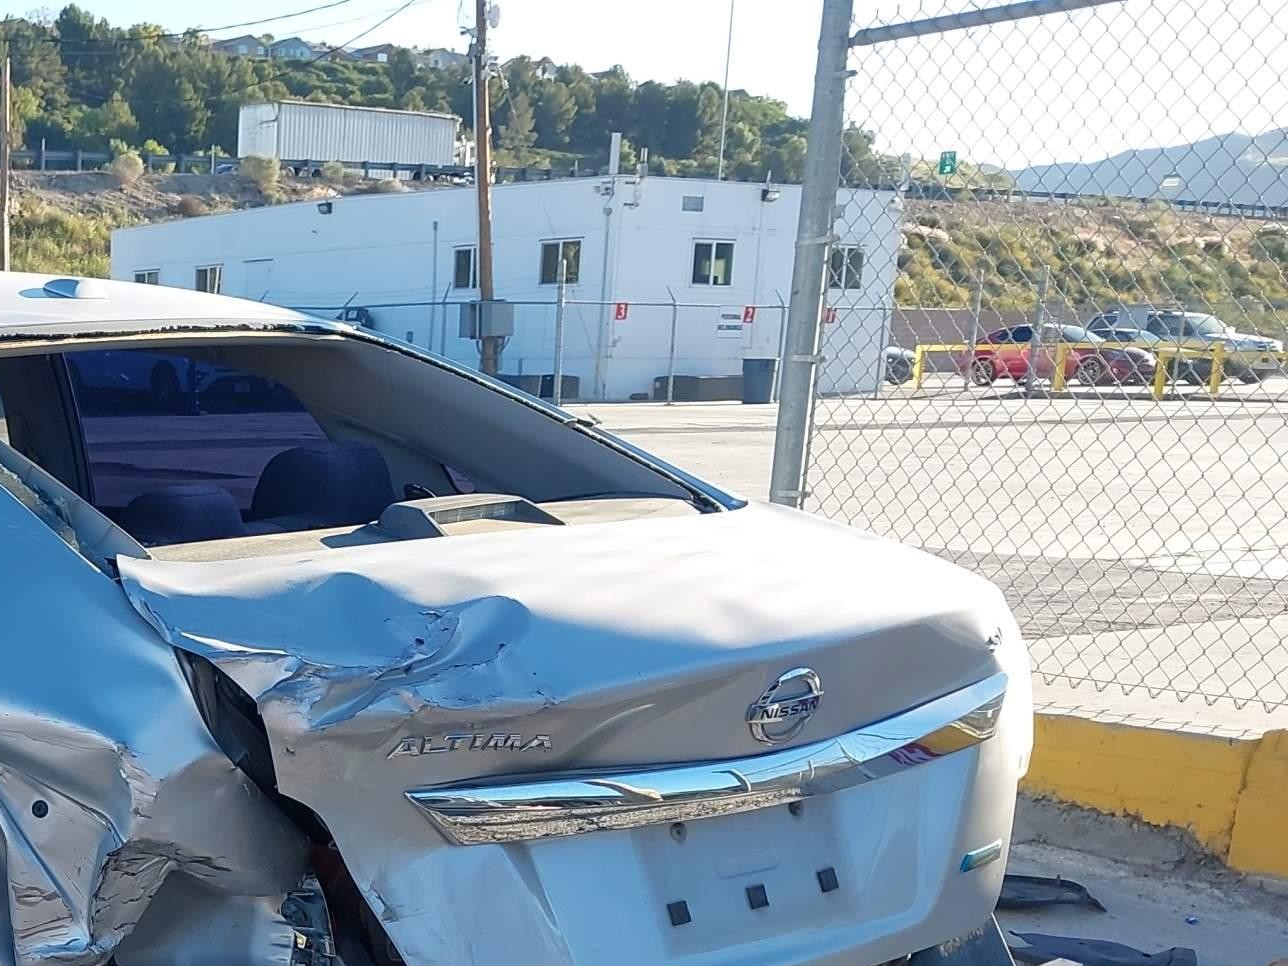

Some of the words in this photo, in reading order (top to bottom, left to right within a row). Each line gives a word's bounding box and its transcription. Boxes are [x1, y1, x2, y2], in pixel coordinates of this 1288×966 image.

[617, 303, 626, 319] 3
[745, 307, 754, 321] 2
[760, 698, 818, 720] NISSAN
[386, 733, 553, 760] ALTIMA
